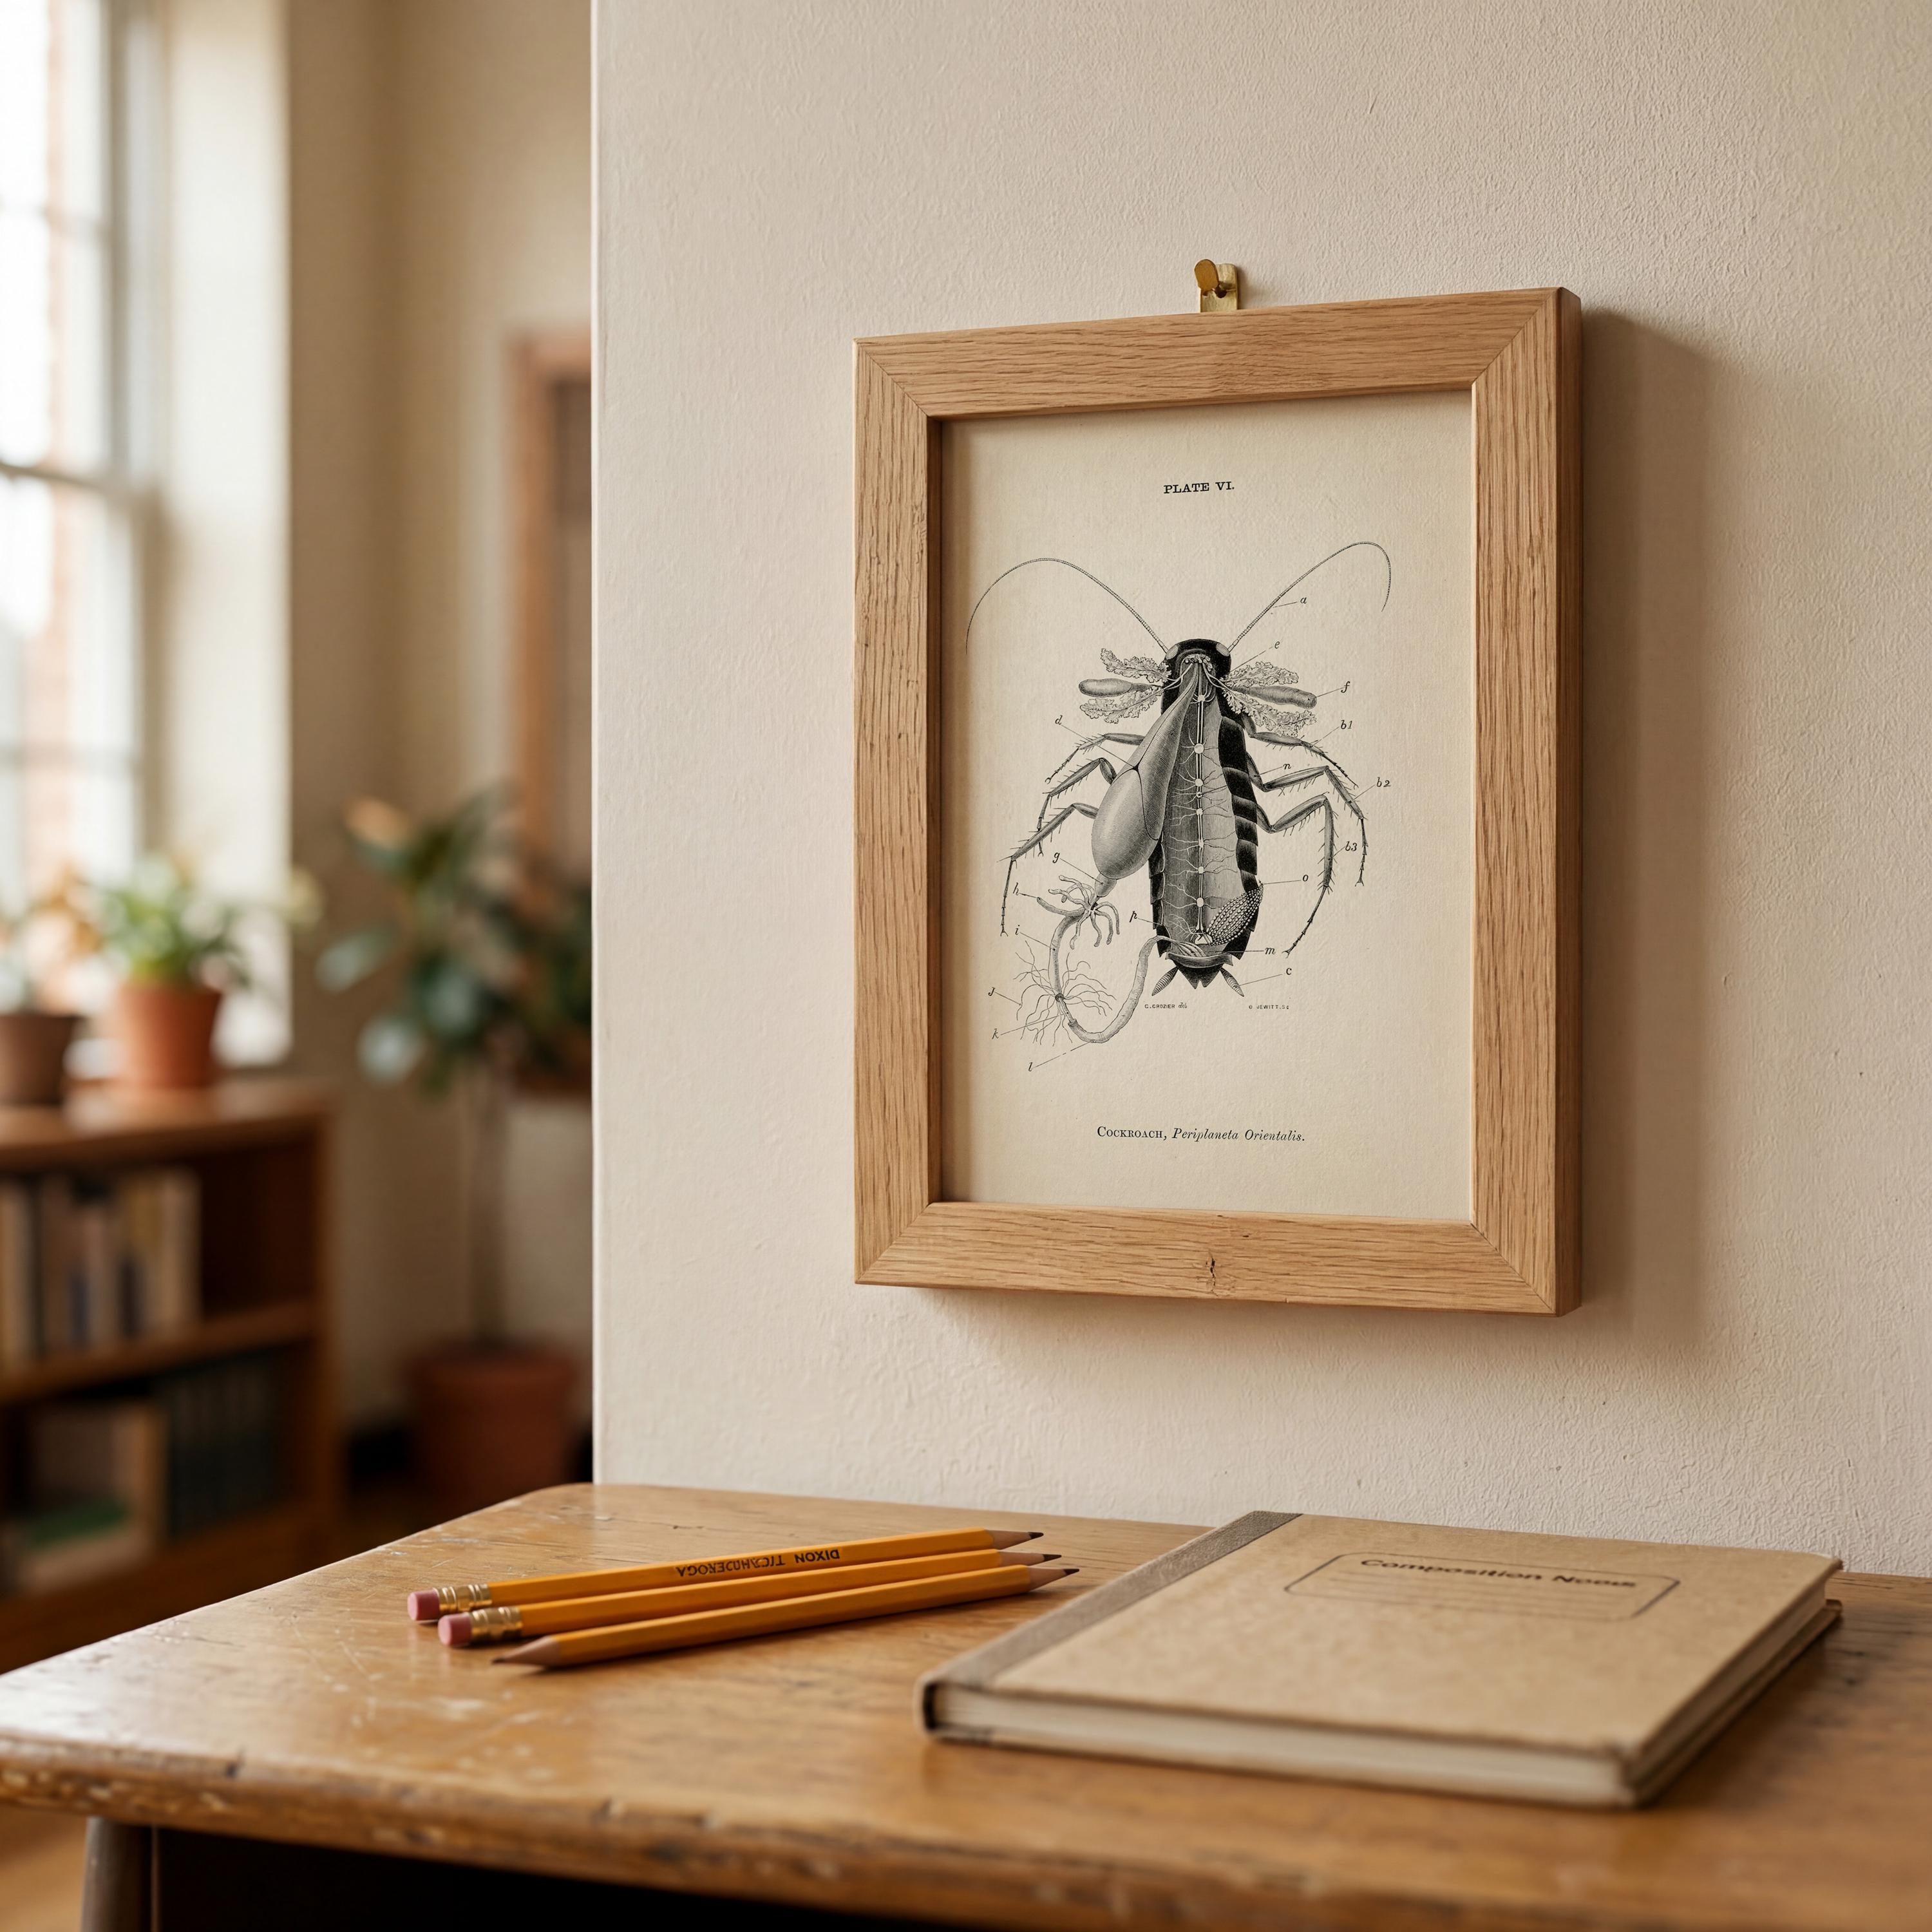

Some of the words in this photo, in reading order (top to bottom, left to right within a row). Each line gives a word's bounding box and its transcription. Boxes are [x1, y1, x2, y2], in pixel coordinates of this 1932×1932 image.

[1163, 482, 1210, 494] PLATE
[1215, 481, 1235, 491] VI.
[1274, 641, 1281, 649] e
[1341, 681, 1350, 694] f
[1054, 714, 1062, 725] d
[1376, 777, 1392, 788] b2
[1345, 840, 1358, 852] b3
[1052, 851, 1061, 864] g
[1302, 874, 1309, 882] o
[1012, 882, 1019, 896] h
[1129, 910, 1138, 923] p
[1015, 924, 1021, 936] i
[992, 1028, 999, 1039] k
[1171, 1128, 1239, 1142] Periplaneta
[1244, 1129, 1305, 1141] Orientalis.
[794, 1549, 840, 1564] DIXON
